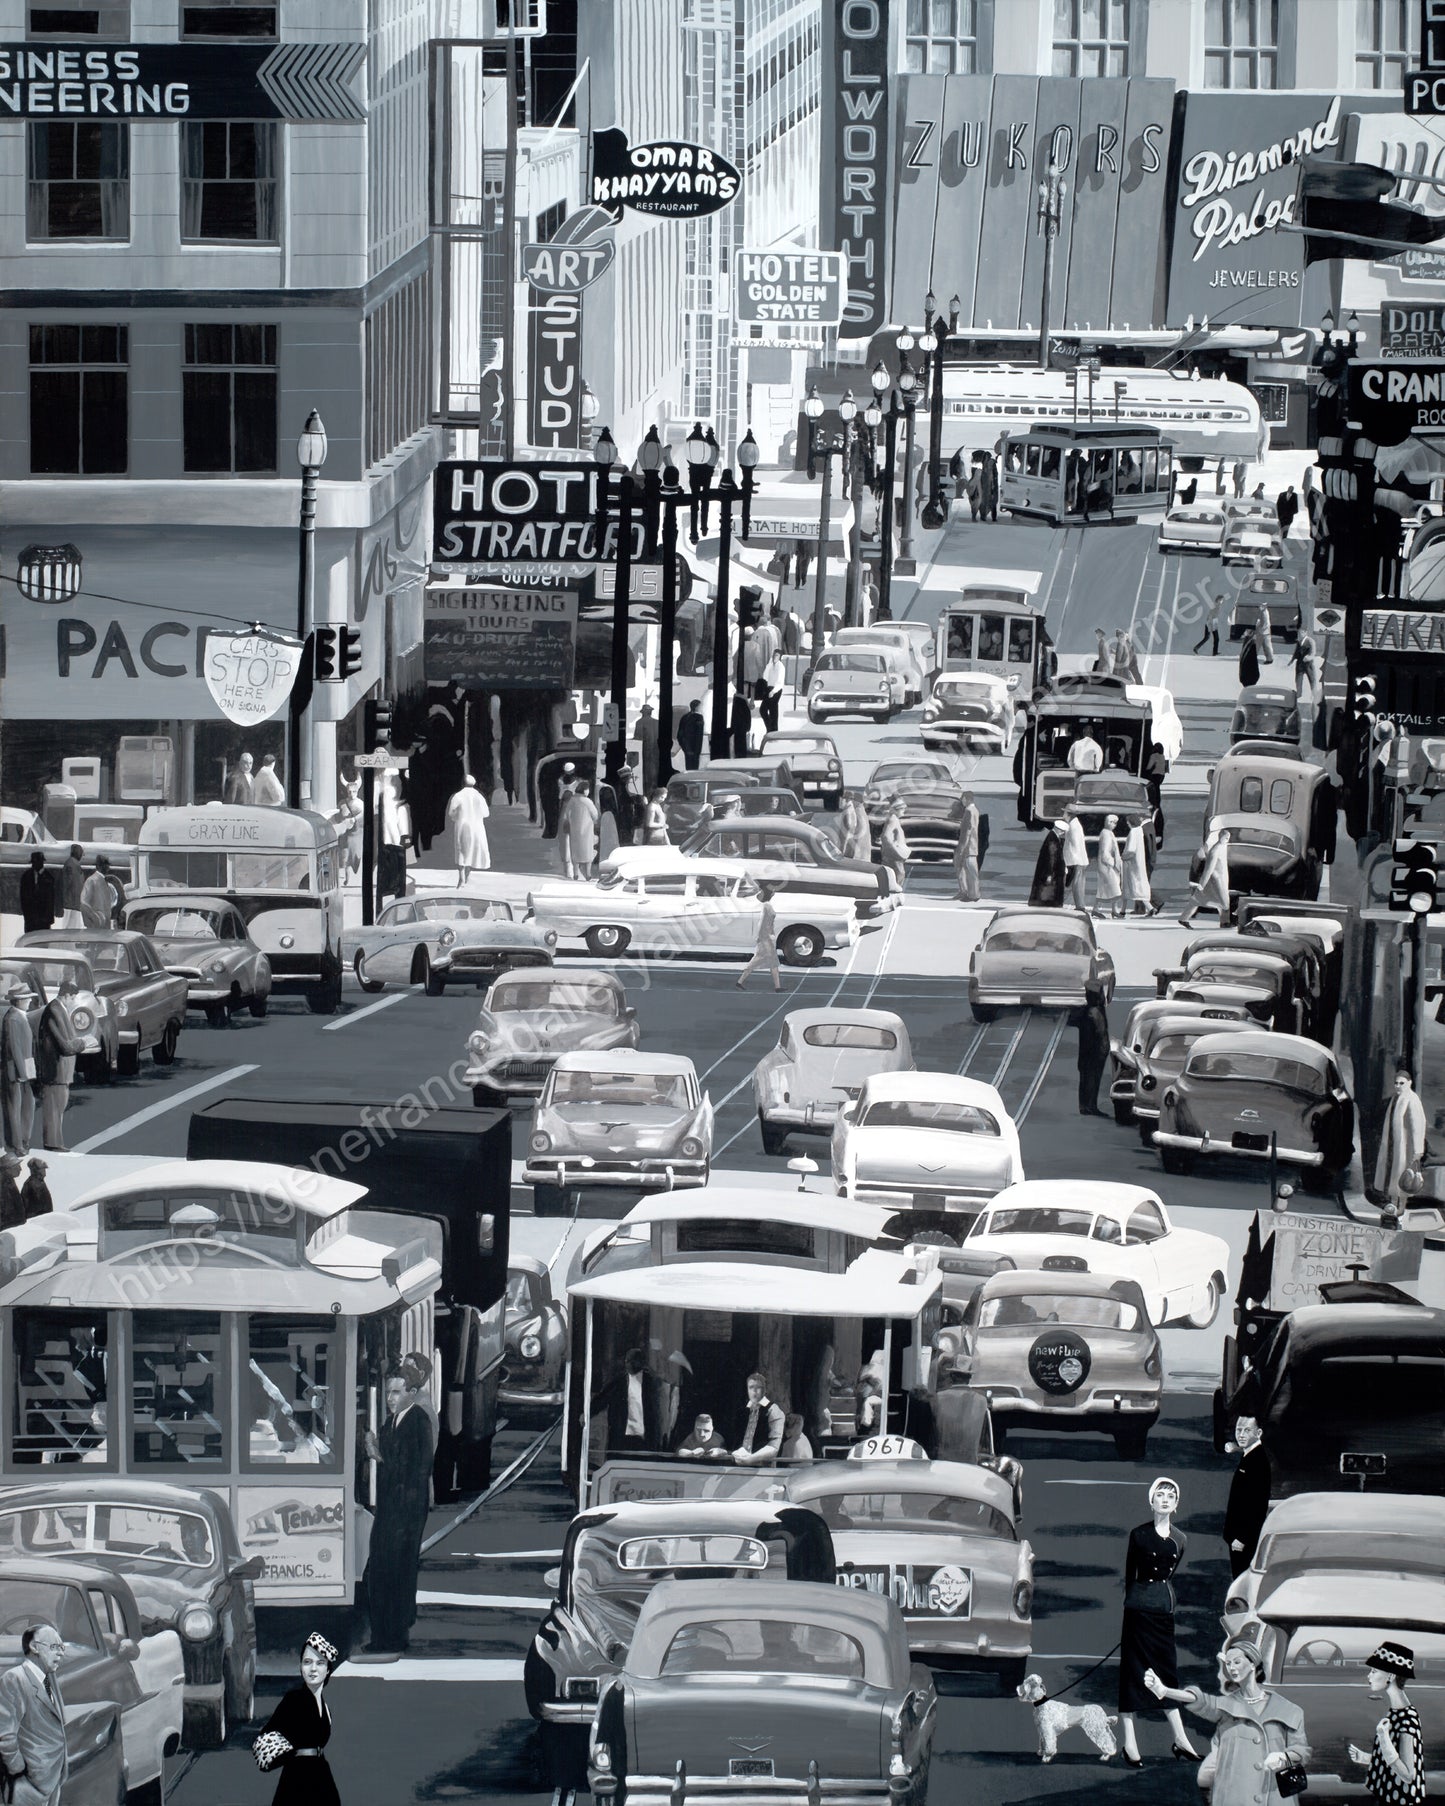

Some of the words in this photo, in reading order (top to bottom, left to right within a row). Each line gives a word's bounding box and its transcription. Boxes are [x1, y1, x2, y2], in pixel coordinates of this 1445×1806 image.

[906, 120, 1164, 173] ZUKORS
[1181, 96, 1341, 206] Diamond
[630, 147, 714, 172] OMAR
[594, 171, 737, 200] KHAYYAM'S
[636, 202, 700, 212] RESTAURANT
[527, 250, 605, 288] ART
[743, 255, 837, 283] HOTEL
[1209, 270, 1299, 288] JEWELERS
[748, 283, 827, 302] GOLDEN
[756, 304, 820, 320] STATE
[229, 637, 279, 658] CARS
[211, 653, 292, 689] STOP
[224, 684, 265, 699] HERE
[360, 755, 400, 766] GEARY
[188, 824, 228, 840] GRAY
[232, 825, 260, 841] LINE
[1302, 1232, 1364, 1255] ZONE
[1306, 1264, 1346, 1279] DRIVE
[866, 1437, 904, 1456] 967
[261, 1564, 315, 1579] FRANCIS
[835, 1572, 885, 1595] new
